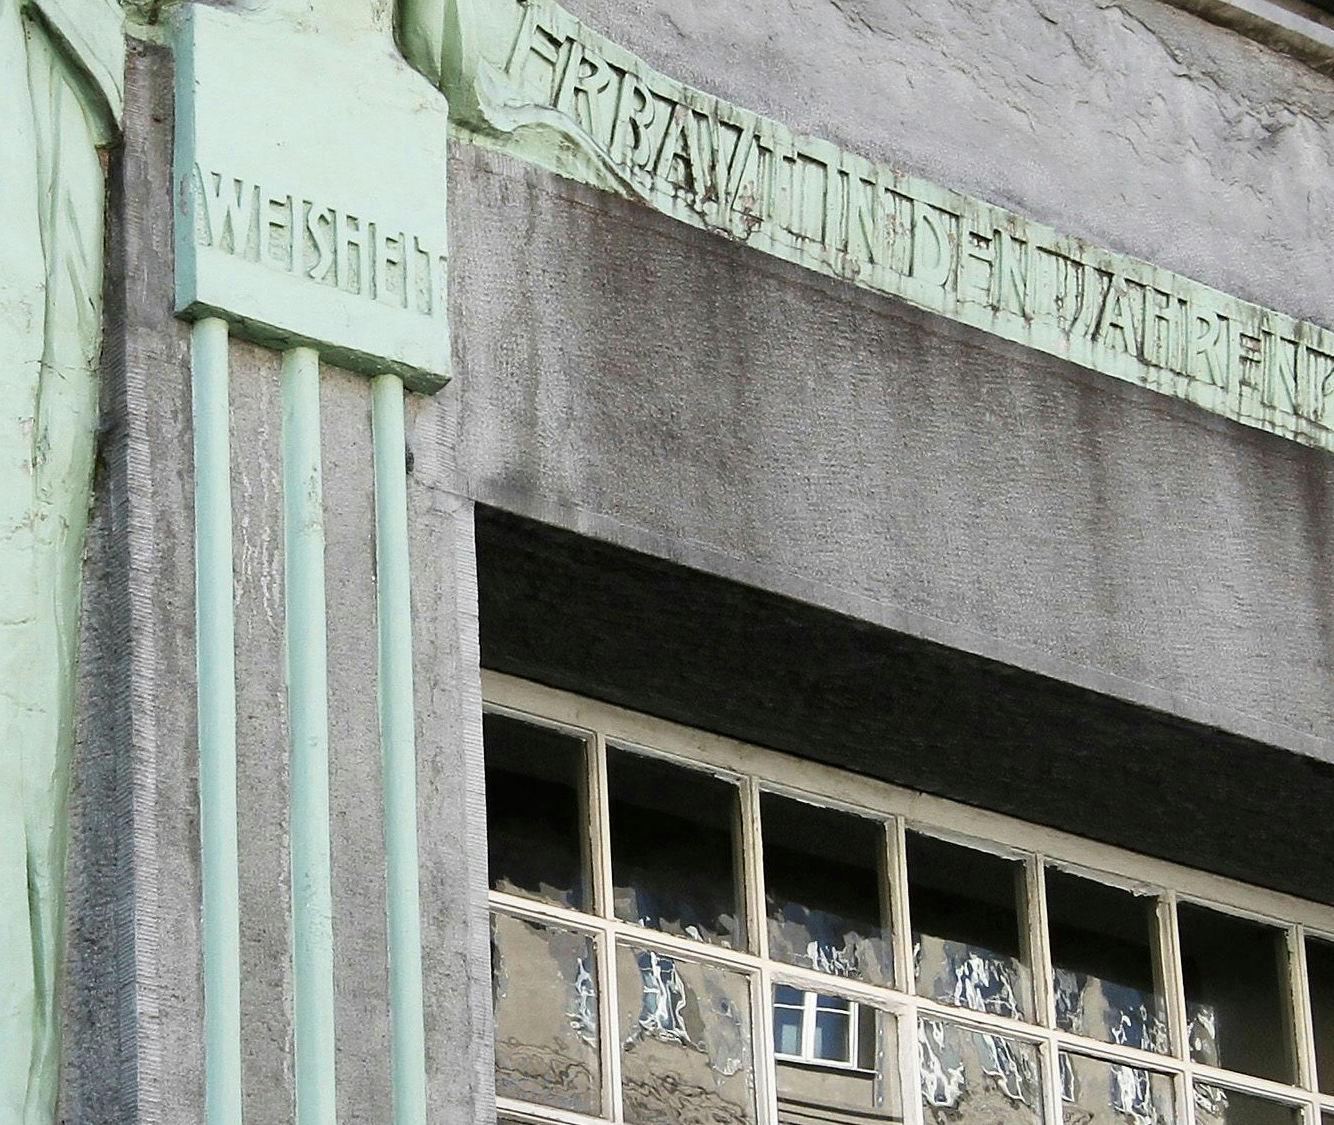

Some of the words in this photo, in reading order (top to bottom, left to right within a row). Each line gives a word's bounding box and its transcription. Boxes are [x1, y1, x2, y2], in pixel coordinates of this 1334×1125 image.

[193, 162, 447, 316] WEISHEIT
[826, 158, 888, 270] IN
[912, 198, 1038, 319] DEN
[1065, 260, 1308, 420] JAHREN
